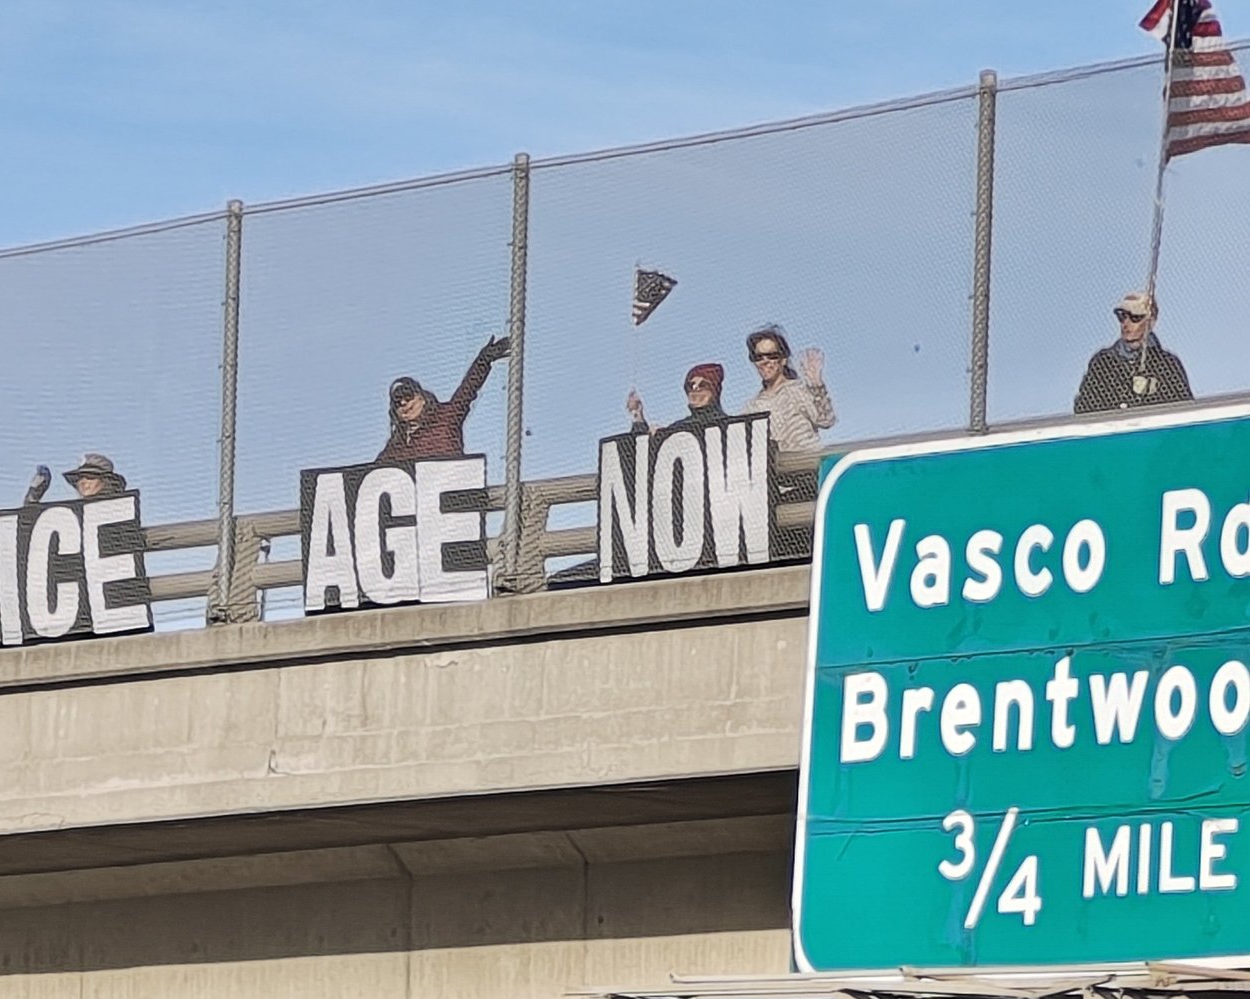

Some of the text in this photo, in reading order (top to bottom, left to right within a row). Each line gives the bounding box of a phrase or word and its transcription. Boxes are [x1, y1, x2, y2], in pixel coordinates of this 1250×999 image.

[305, 458, 488, 611] AGE
[600, 418, 769, 583] NOW
[853, 519, 1107, 612] Vasco
[840, 655, 1250, 764] Brentwoo
[938, 807, 1239, 930] 3/4 MILE
